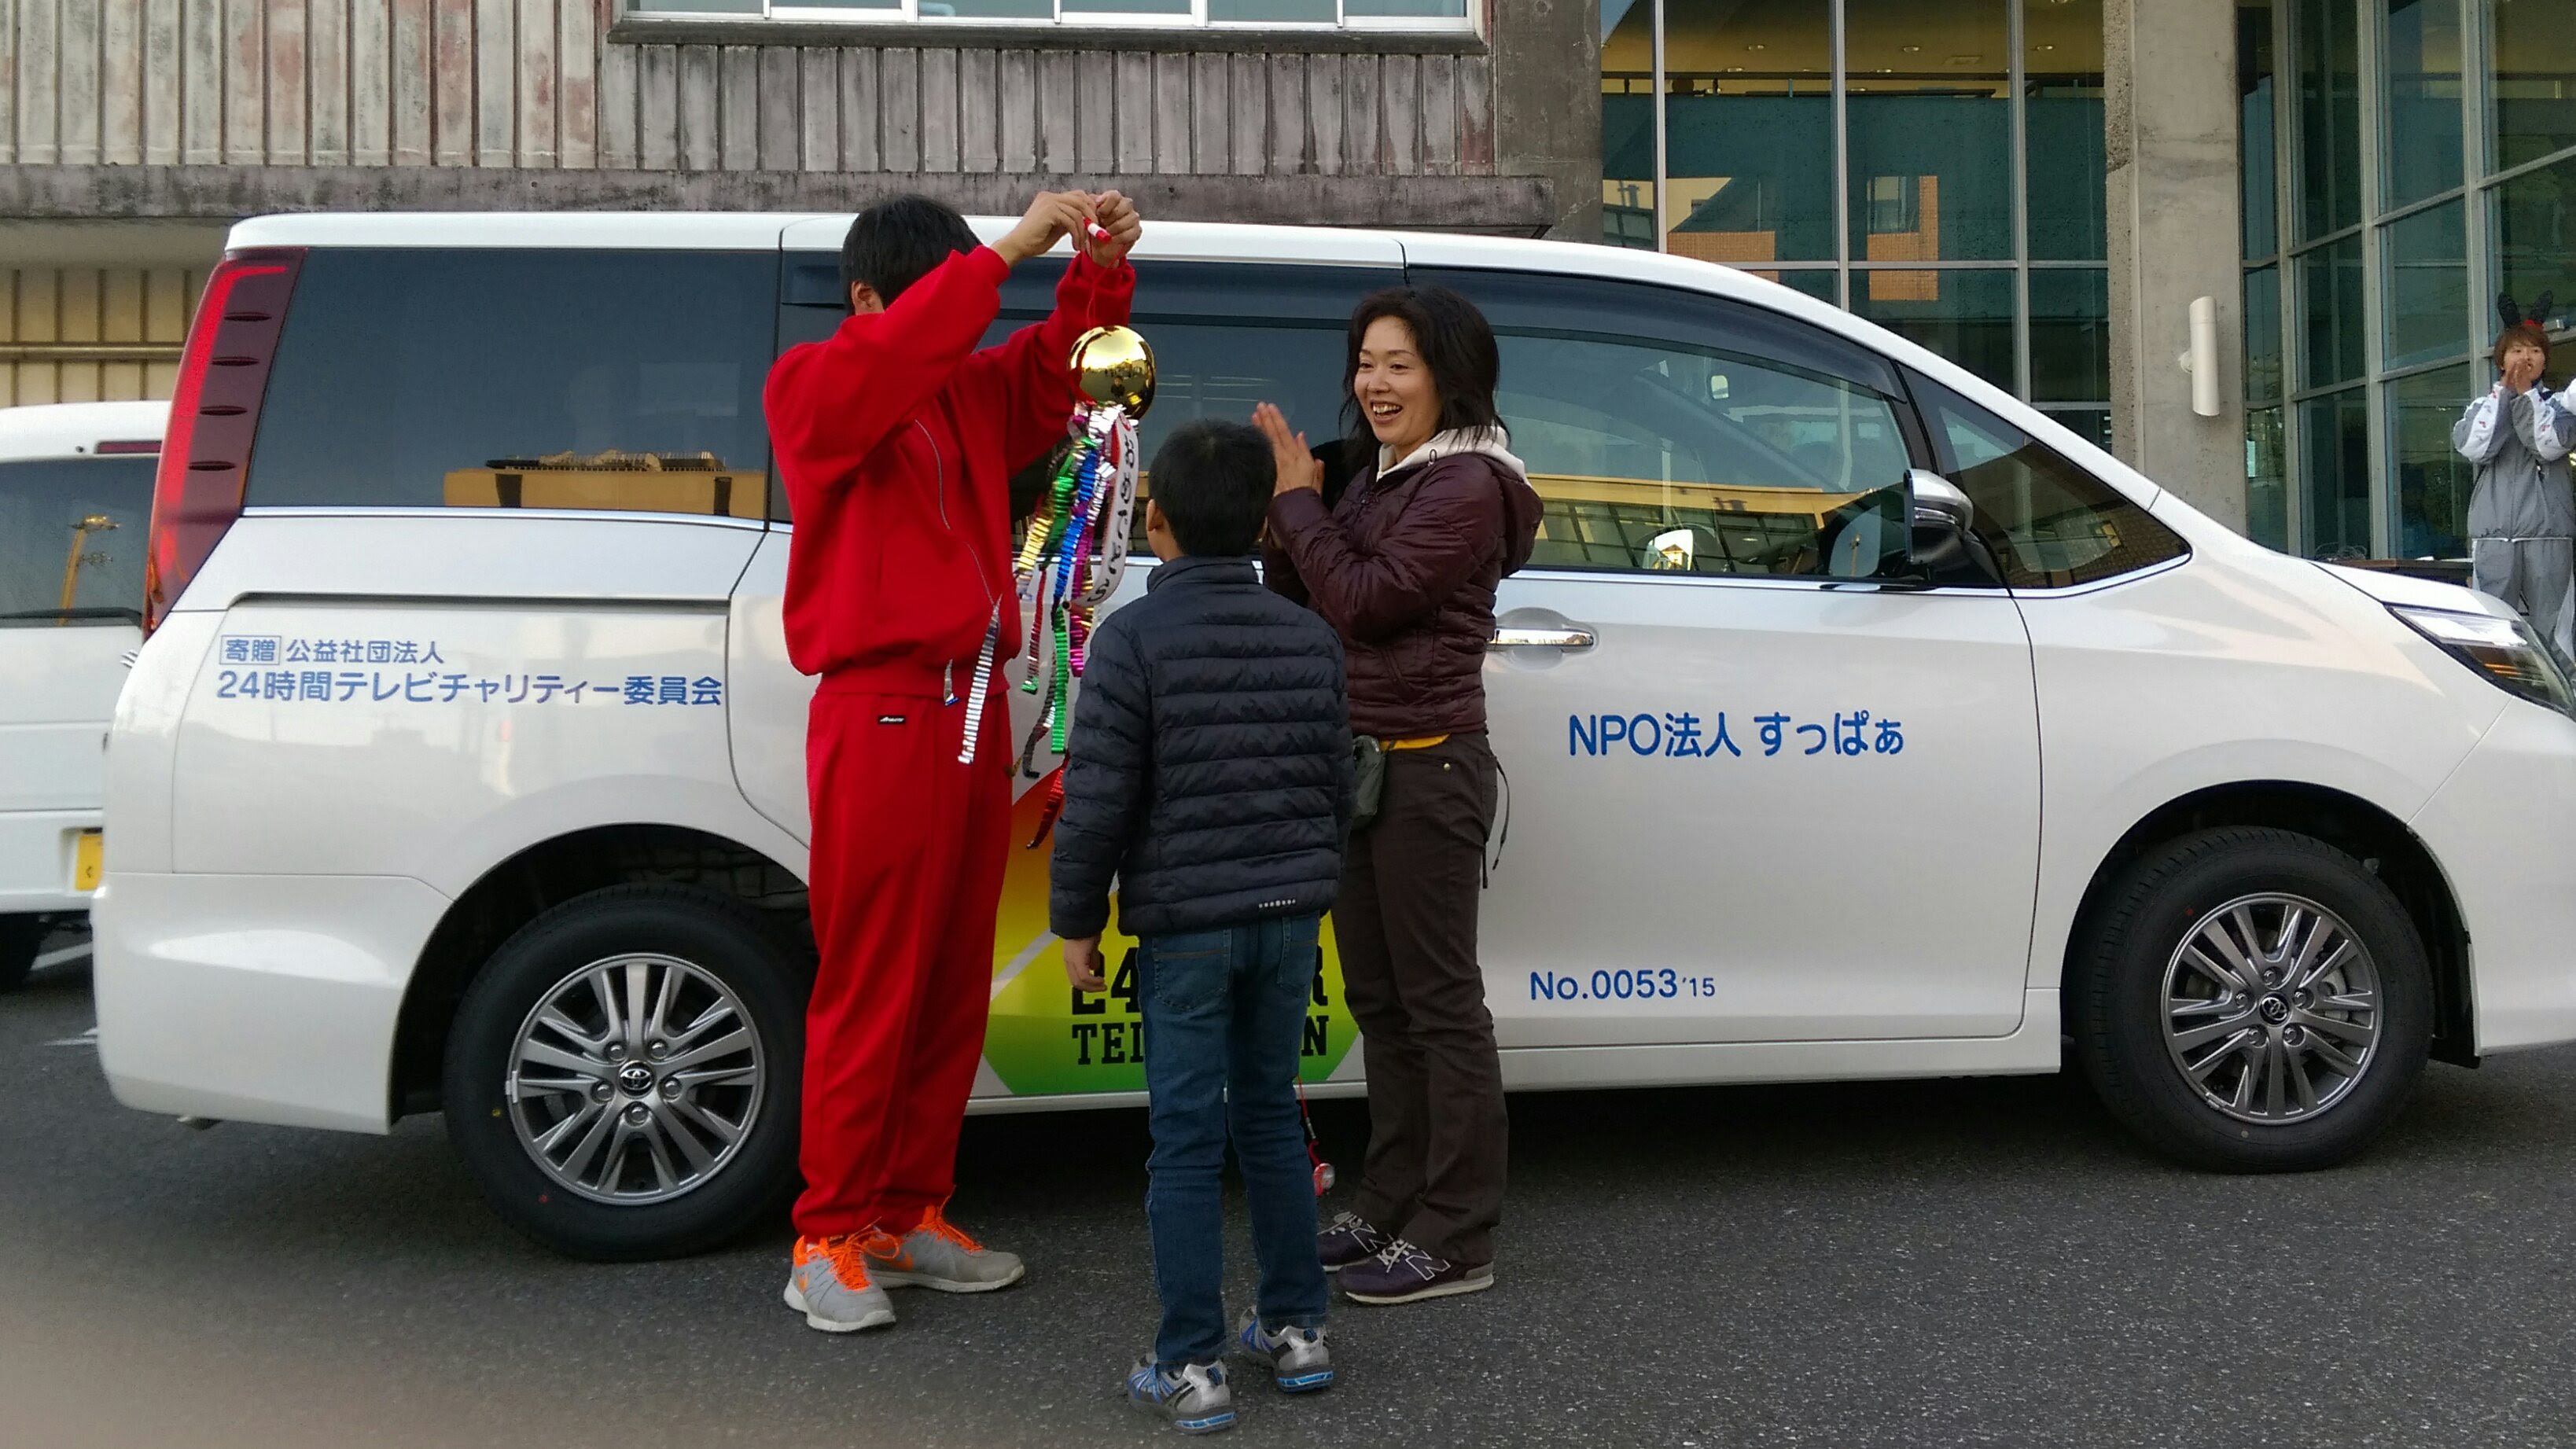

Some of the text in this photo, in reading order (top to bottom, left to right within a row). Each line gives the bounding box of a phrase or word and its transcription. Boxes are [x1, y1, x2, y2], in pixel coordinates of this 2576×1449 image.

[225, 638, 444, 664] 寄贈 公益社団法人
[217, 670, 723, 706] 24時間テレビチャリティー委員会
[1570, 709, 1904, 758] NPO法人 すっぱぁ
